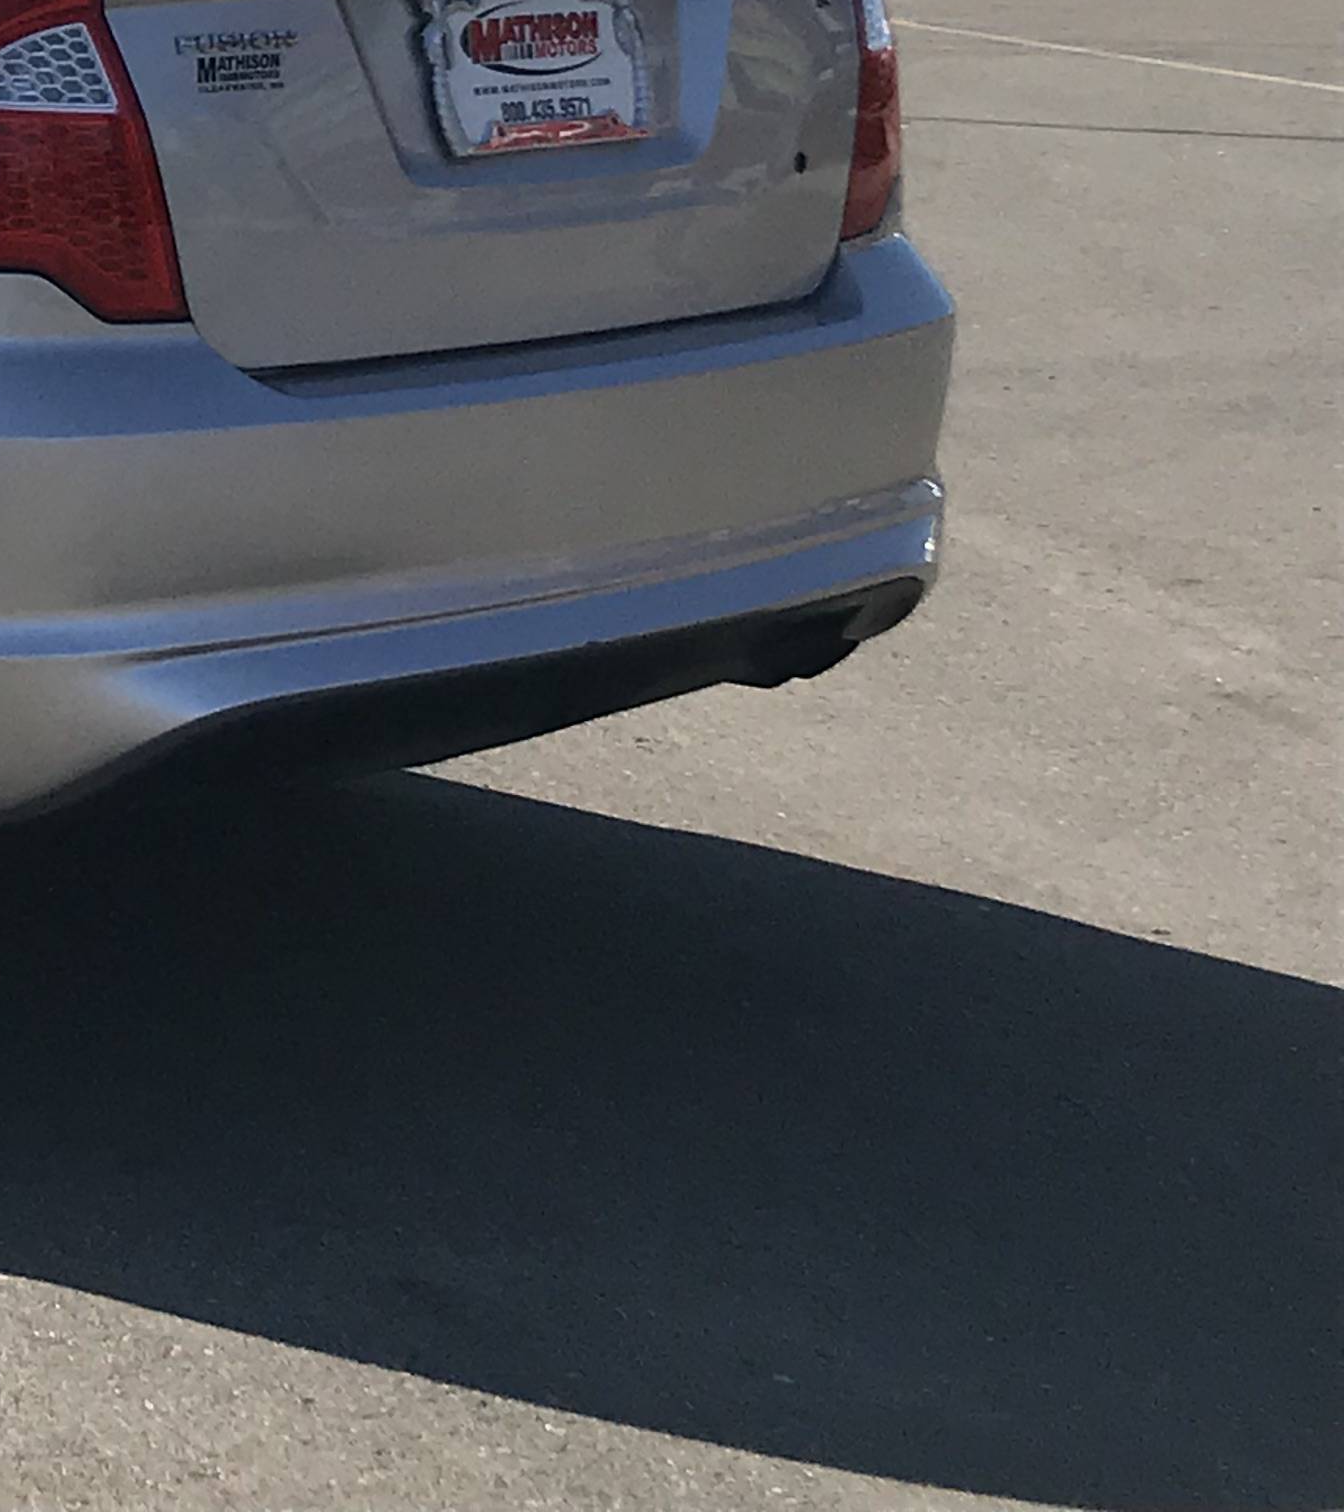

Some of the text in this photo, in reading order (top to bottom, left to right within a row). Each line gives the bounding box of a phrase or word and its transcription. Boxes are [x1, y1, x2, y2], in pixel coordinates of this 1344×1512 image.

[469, 11, 598, 65] MATHISON
[535, 39, 598, 59] MOTORS
[196, 54, 280, 83] MATHISON
